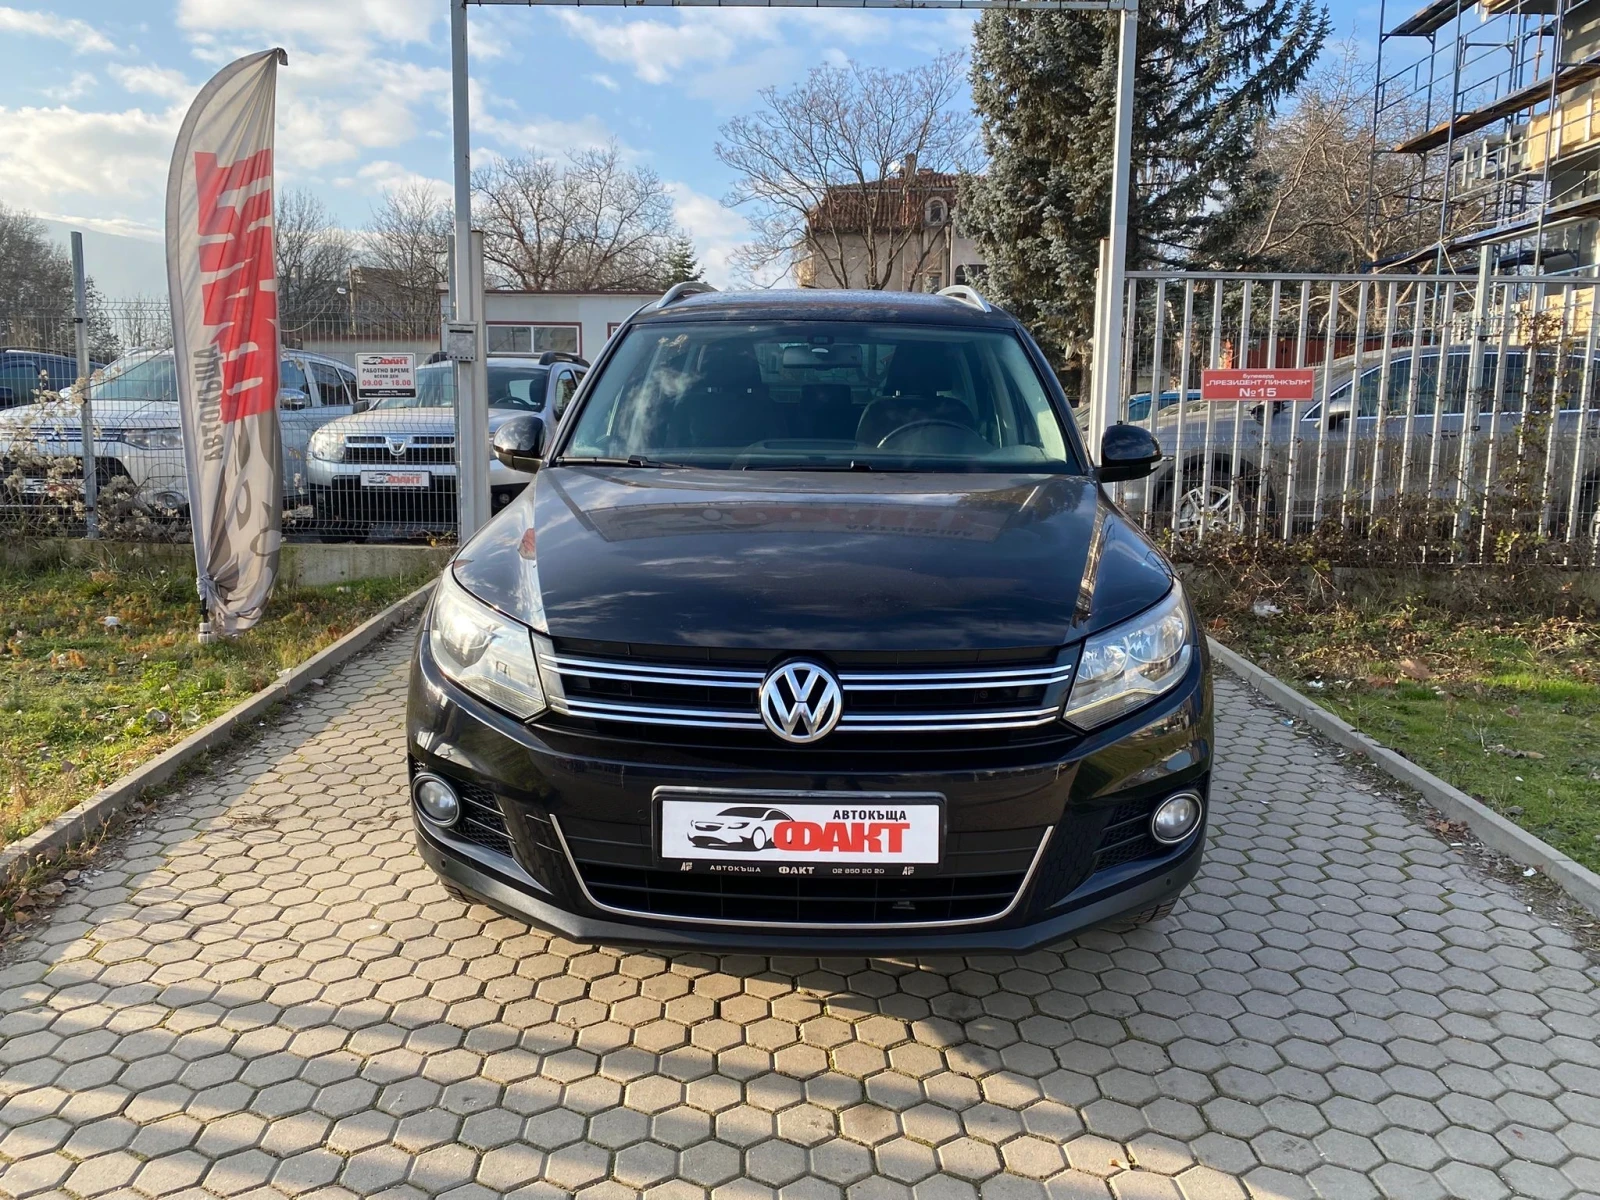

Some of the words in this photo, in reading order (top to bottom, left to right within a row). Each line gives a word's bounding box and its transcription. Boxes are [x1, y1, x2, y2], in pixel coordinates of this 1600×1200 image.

[193, 344, 224, 462] АВТОКЪЩА
[833, 809, 907, 821] АВТОКЪЩА
[773, 821, 911, 853] ФАКТ
[778, 866, 815, 874] ФАКТ
